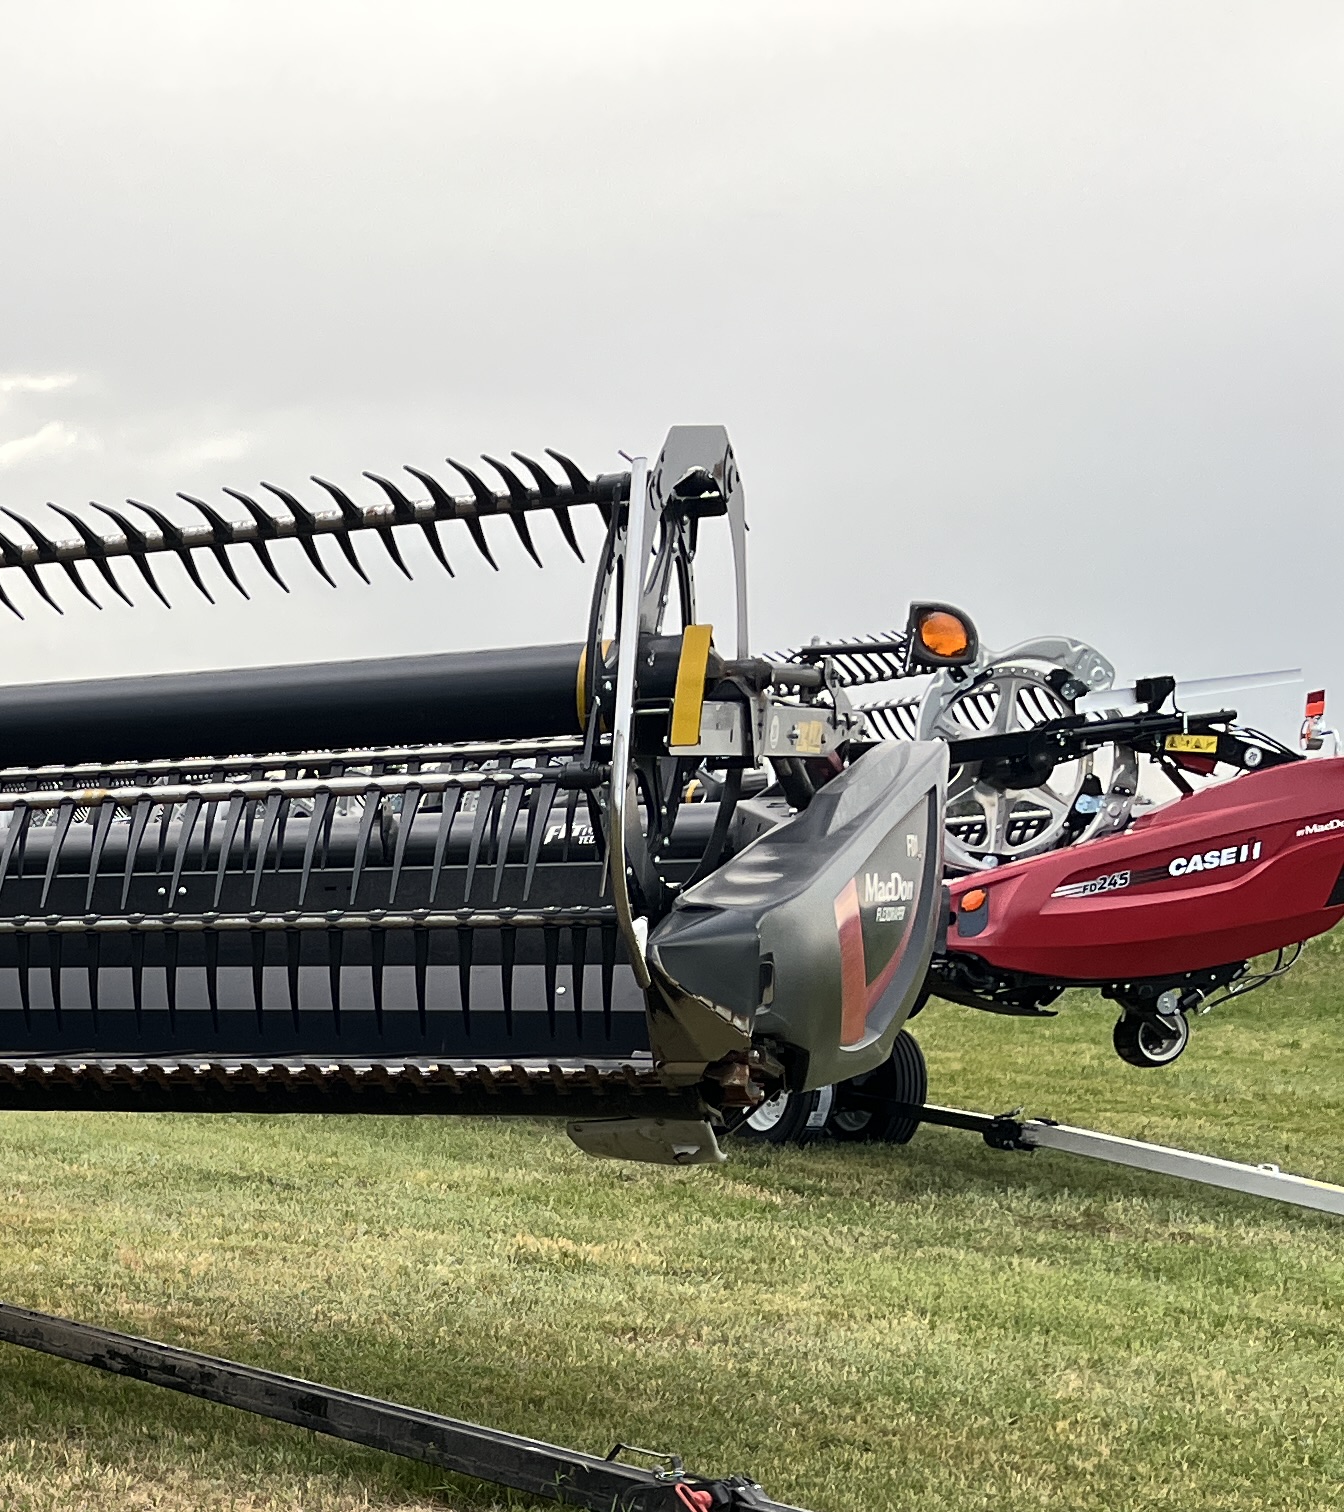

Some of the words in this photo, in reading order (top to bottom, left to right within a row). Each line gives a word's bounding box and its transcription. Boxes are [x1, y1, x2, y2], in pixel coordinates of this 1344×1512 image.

[1305, 819, 1344, 835] MacDo
[1168, 847, 1238, 877] CASE
[865, 872, 914, 902] MacDon
[1082, 871, 1129, 894] FD245
